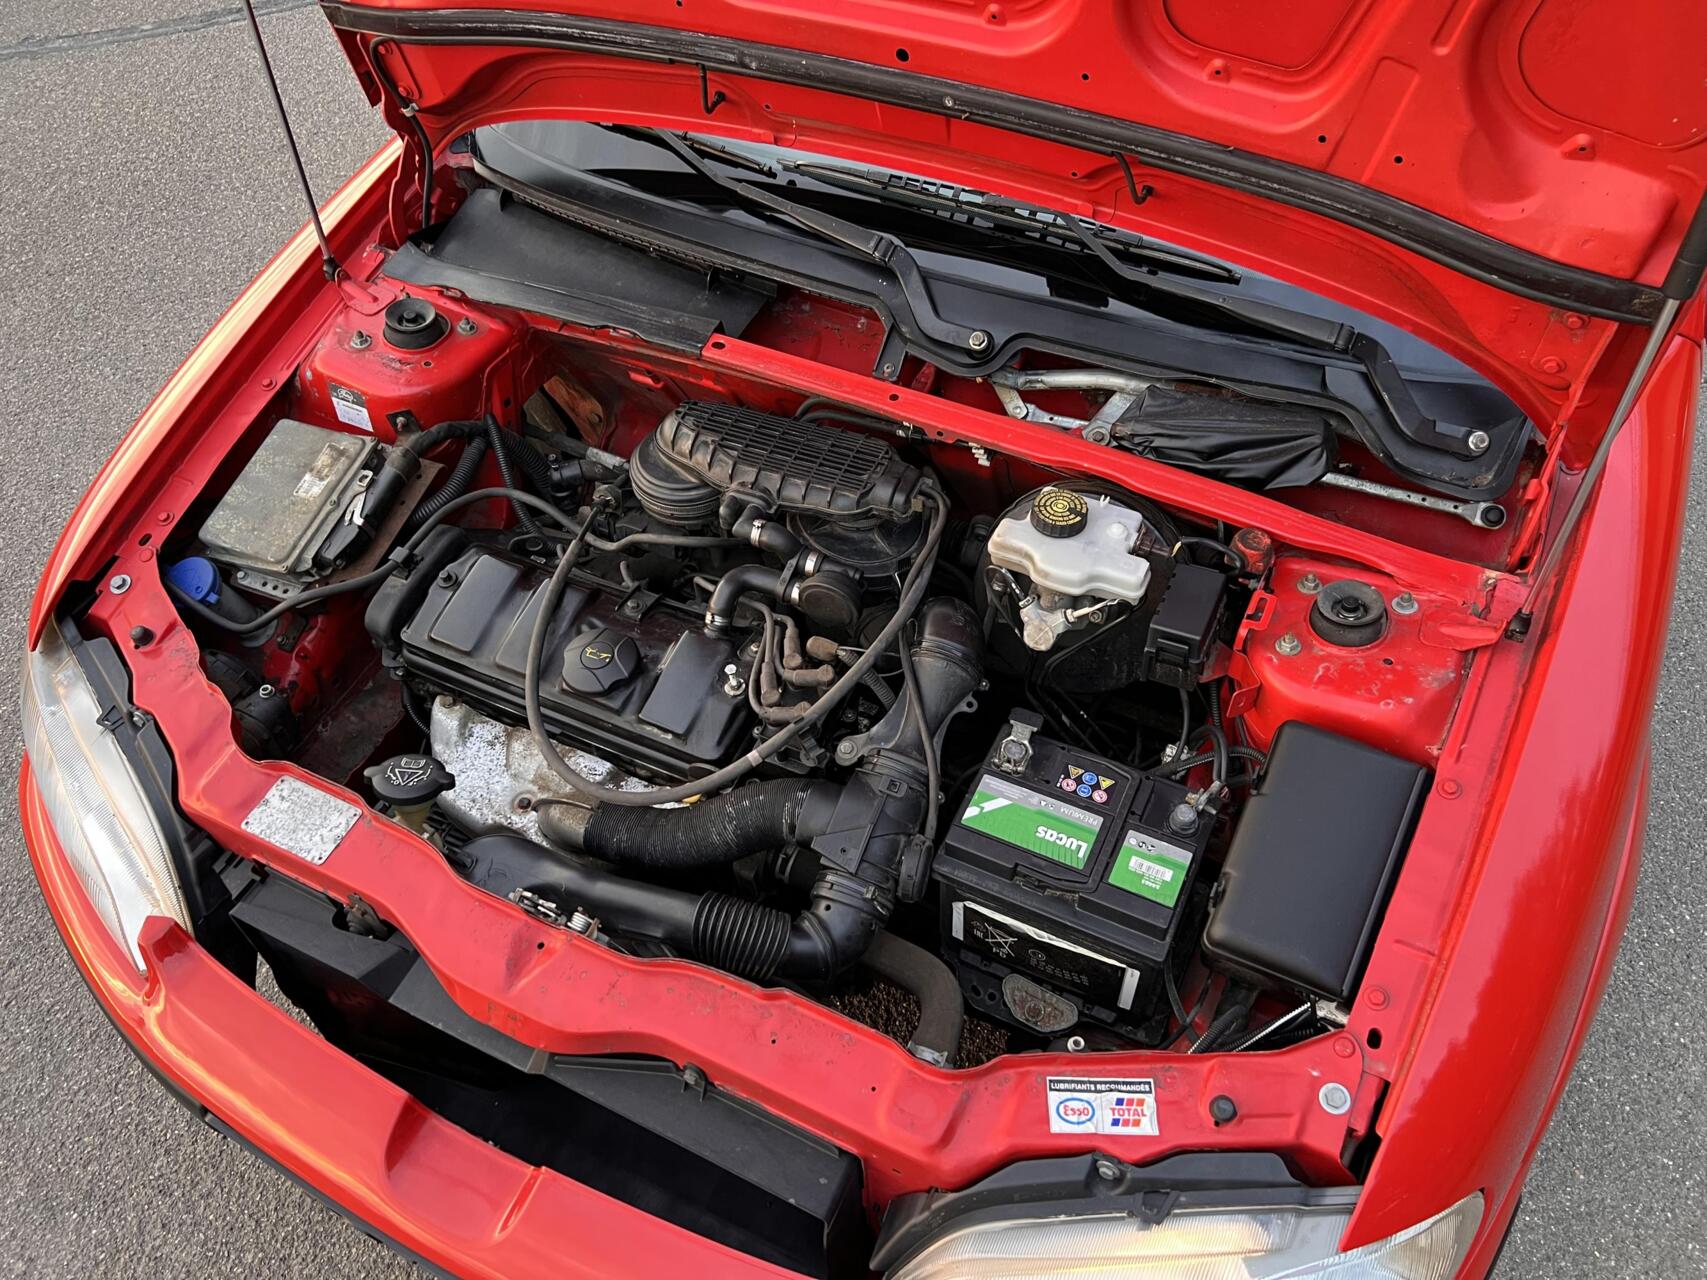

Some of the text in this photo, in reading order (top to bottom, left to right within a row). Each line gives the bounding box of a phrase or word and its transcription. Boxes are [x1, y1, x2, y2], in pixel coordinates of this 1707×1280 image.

[1060, 807, 1098, 825] PREMIUM
[1036, 825, 1088, 858] Lucas
[1051, 1082, 1095, 1091] LUBRIFIANTS
[1110, 1107, 1147, 1117] TOTAL
